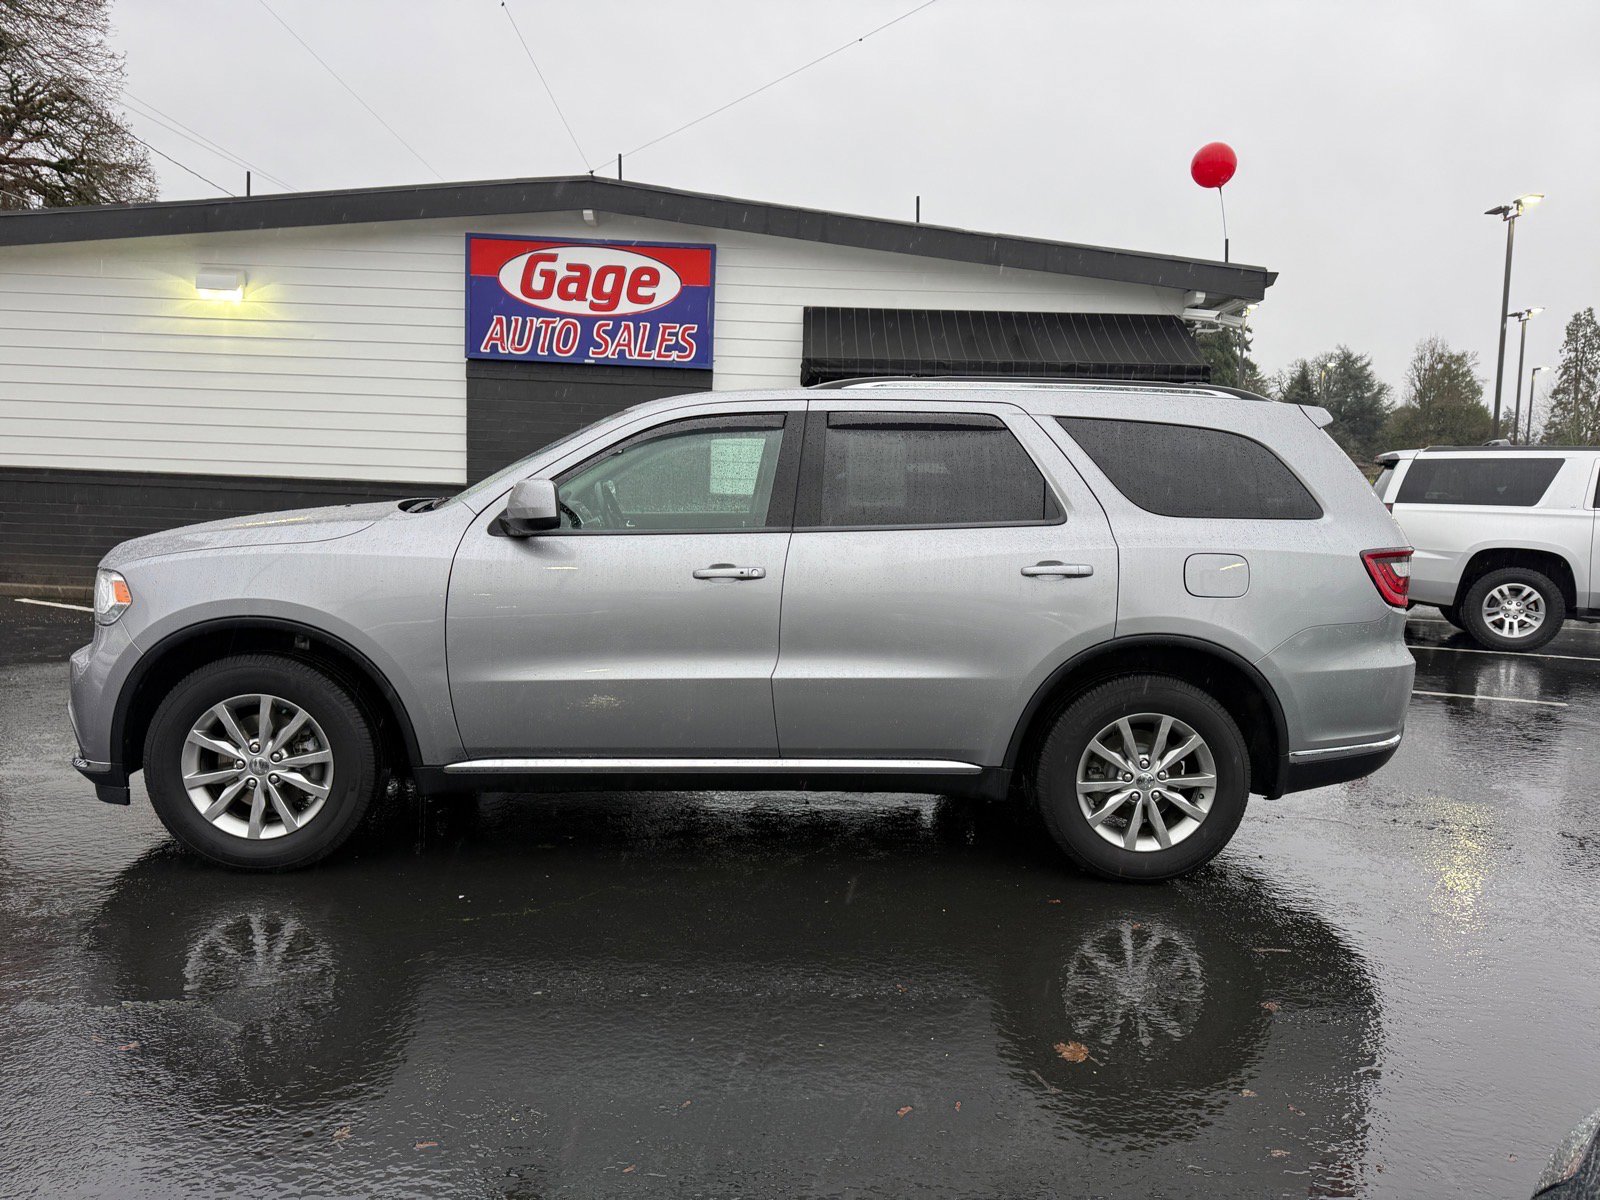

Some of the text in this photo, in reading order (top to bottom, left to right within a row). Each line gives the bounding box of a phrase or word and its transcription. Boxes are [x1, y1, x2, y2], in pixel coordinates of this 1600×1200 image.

[520, 252, 661, 312] Gage
[480, 315, 698, 362] AUTO SALES
